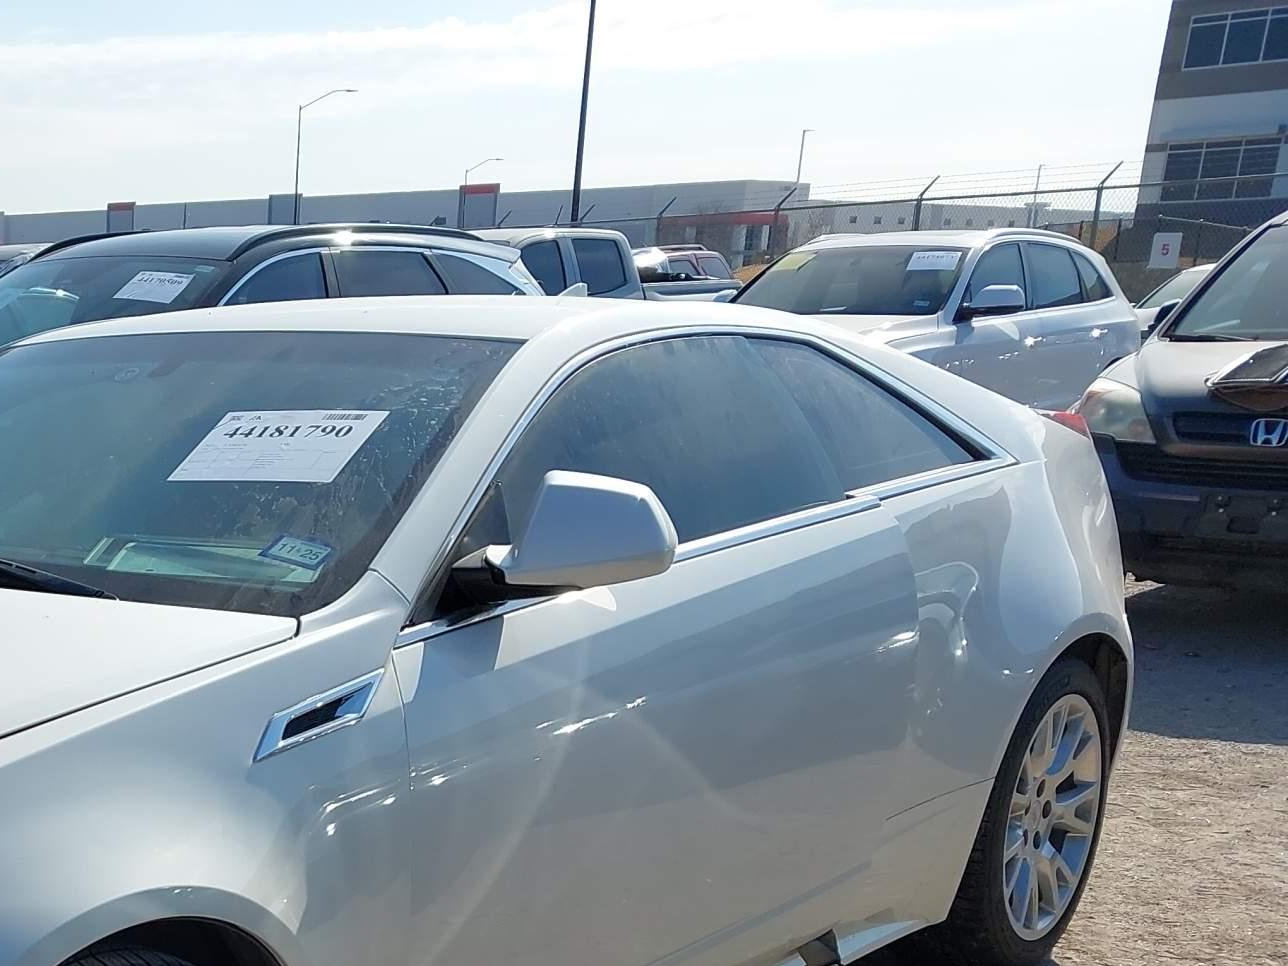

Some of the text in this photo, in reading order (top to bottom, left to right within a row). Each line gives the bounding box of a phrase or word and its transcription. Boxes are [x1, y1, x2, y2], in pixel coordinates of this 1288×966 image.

[1161, 243, 1170, 256] 5
[223, 424, 354, 439] 44181790
[299, 549, 321, 561] 25
